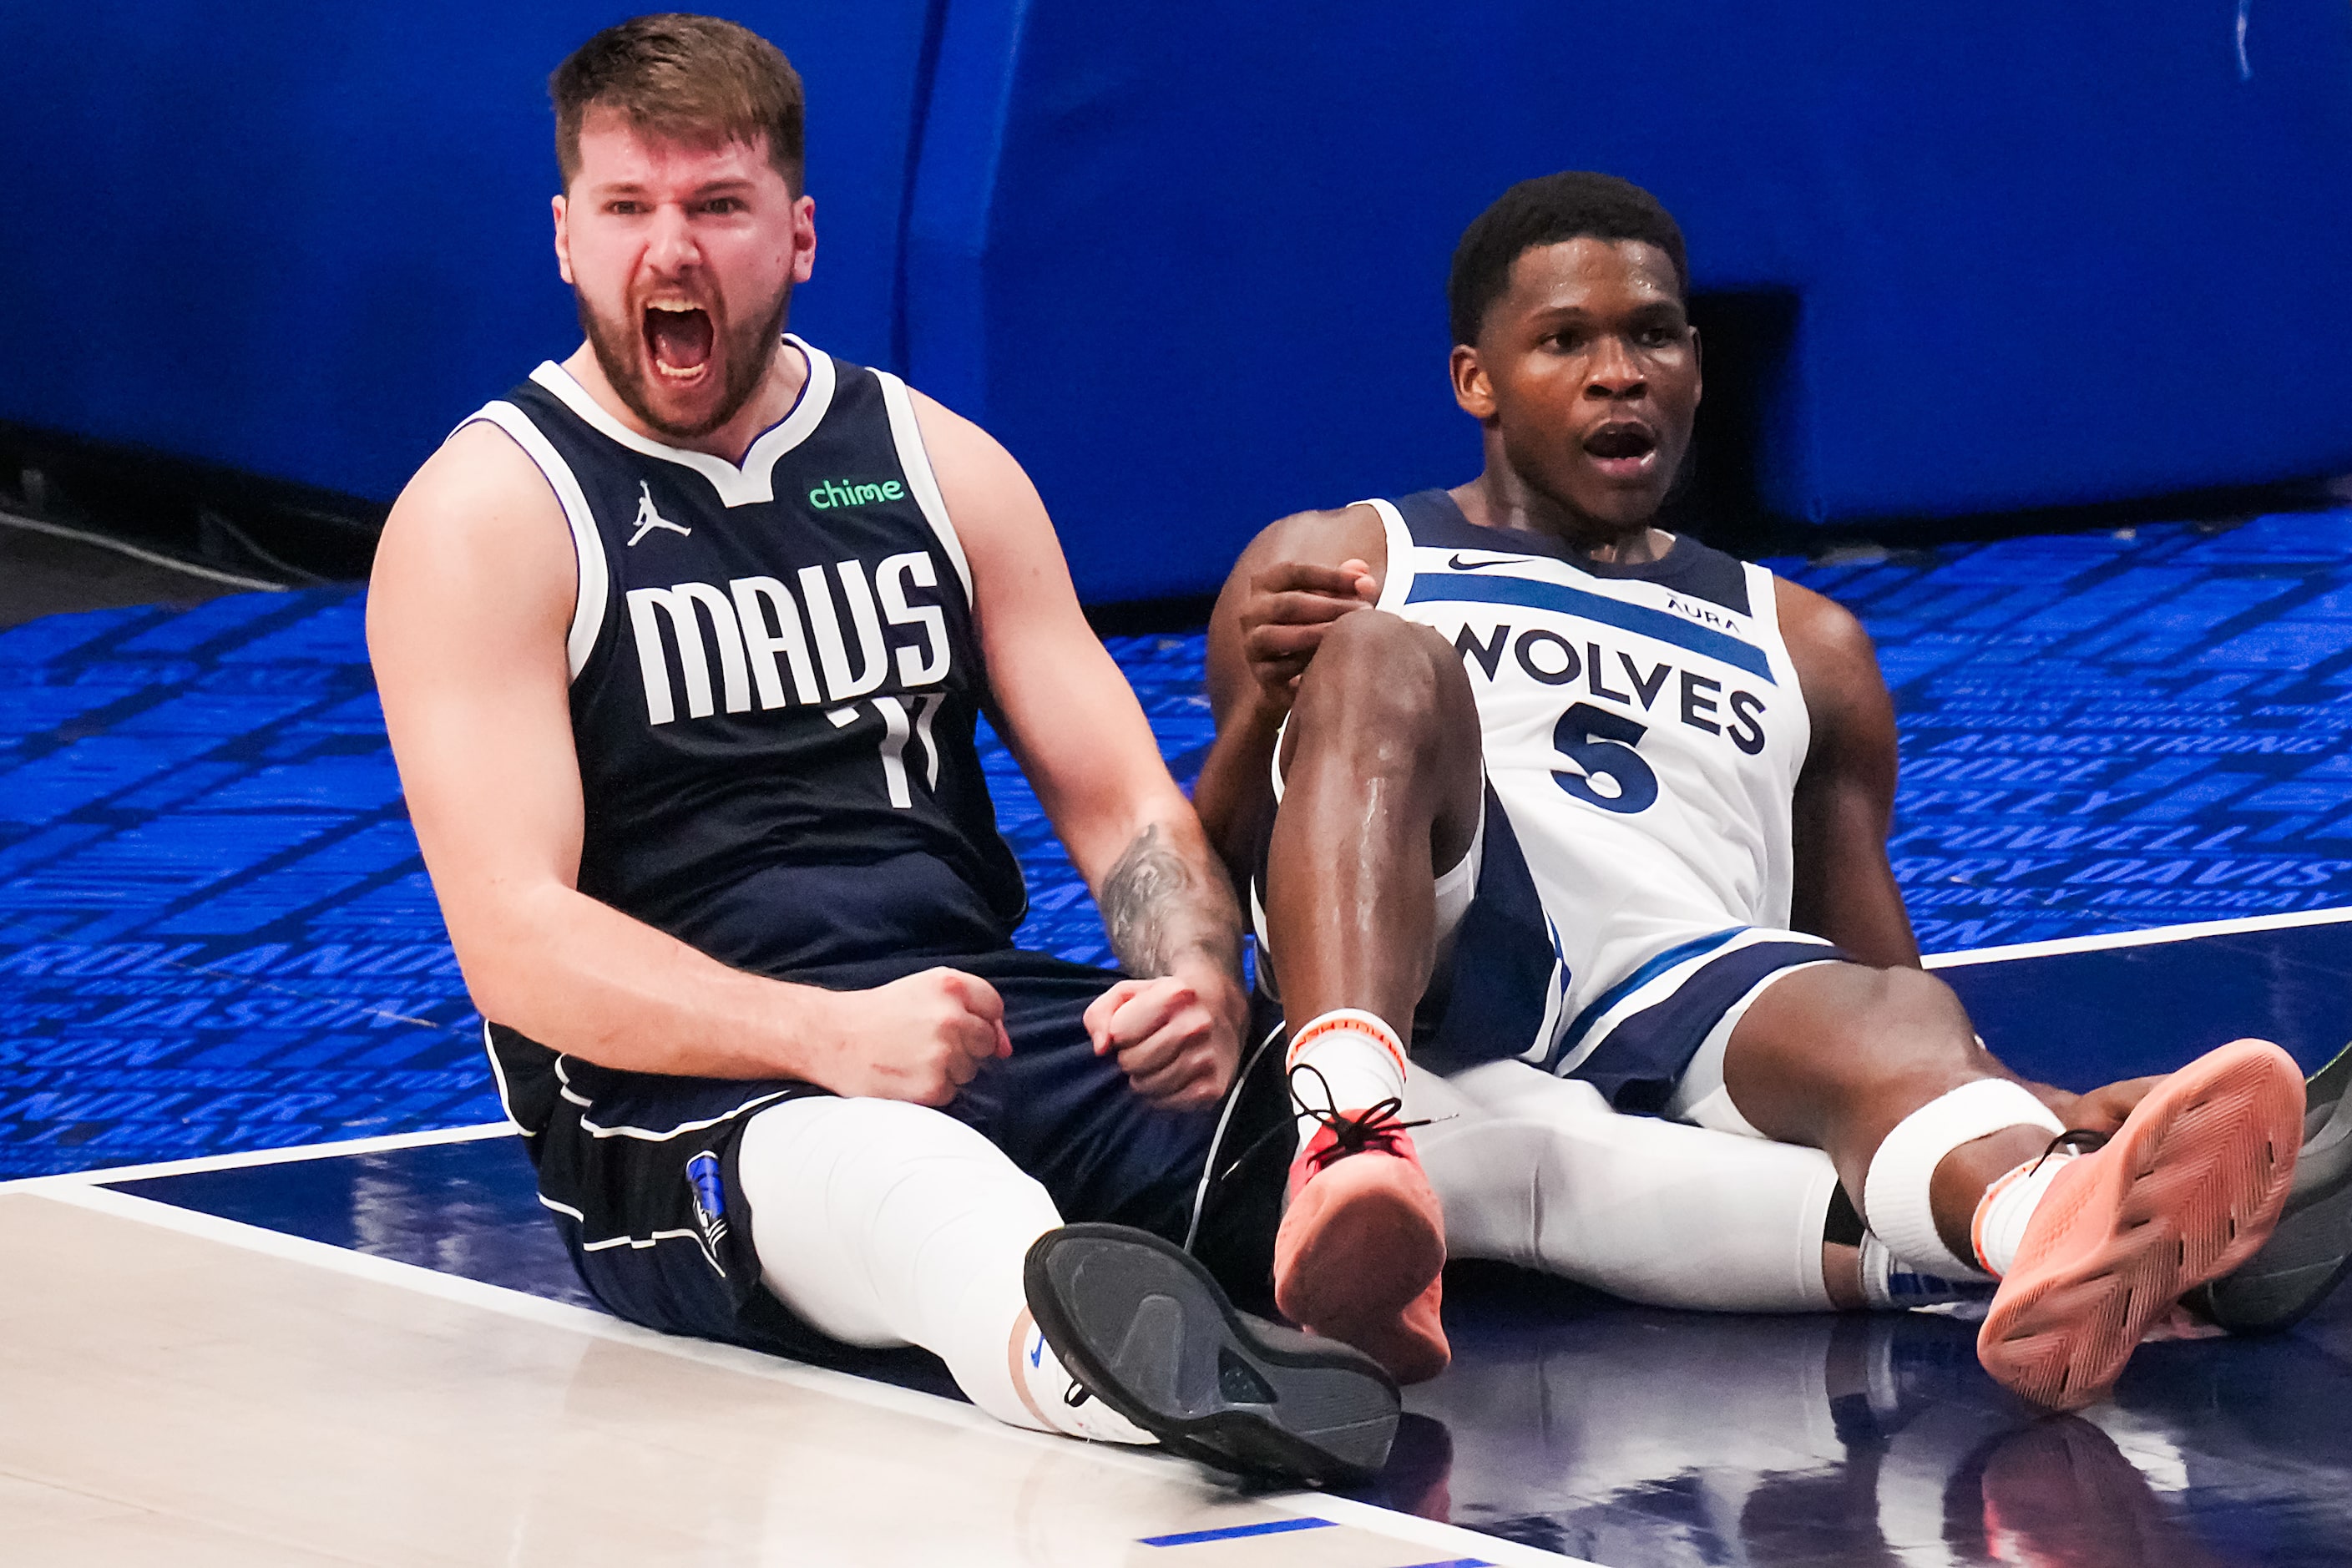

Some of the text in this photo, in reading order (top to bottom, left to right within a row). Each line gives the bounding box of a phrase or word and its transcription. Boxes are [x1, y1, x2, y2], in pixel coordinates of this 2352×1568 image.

[809, 478, 905, 509] chime
[626, 551, 951, 726] MAVS
[1454, 622, 1767, 755] WOLVES
[1550, 701, 1658, 814] 5
[1925, 734, 2342, 753] ARMSTRONG
[1897, 756, 2137, 782] ODGE
[2063, 859, 2352, 886] DAVIS
[1900, 888, 2087, 906] ODNEY
